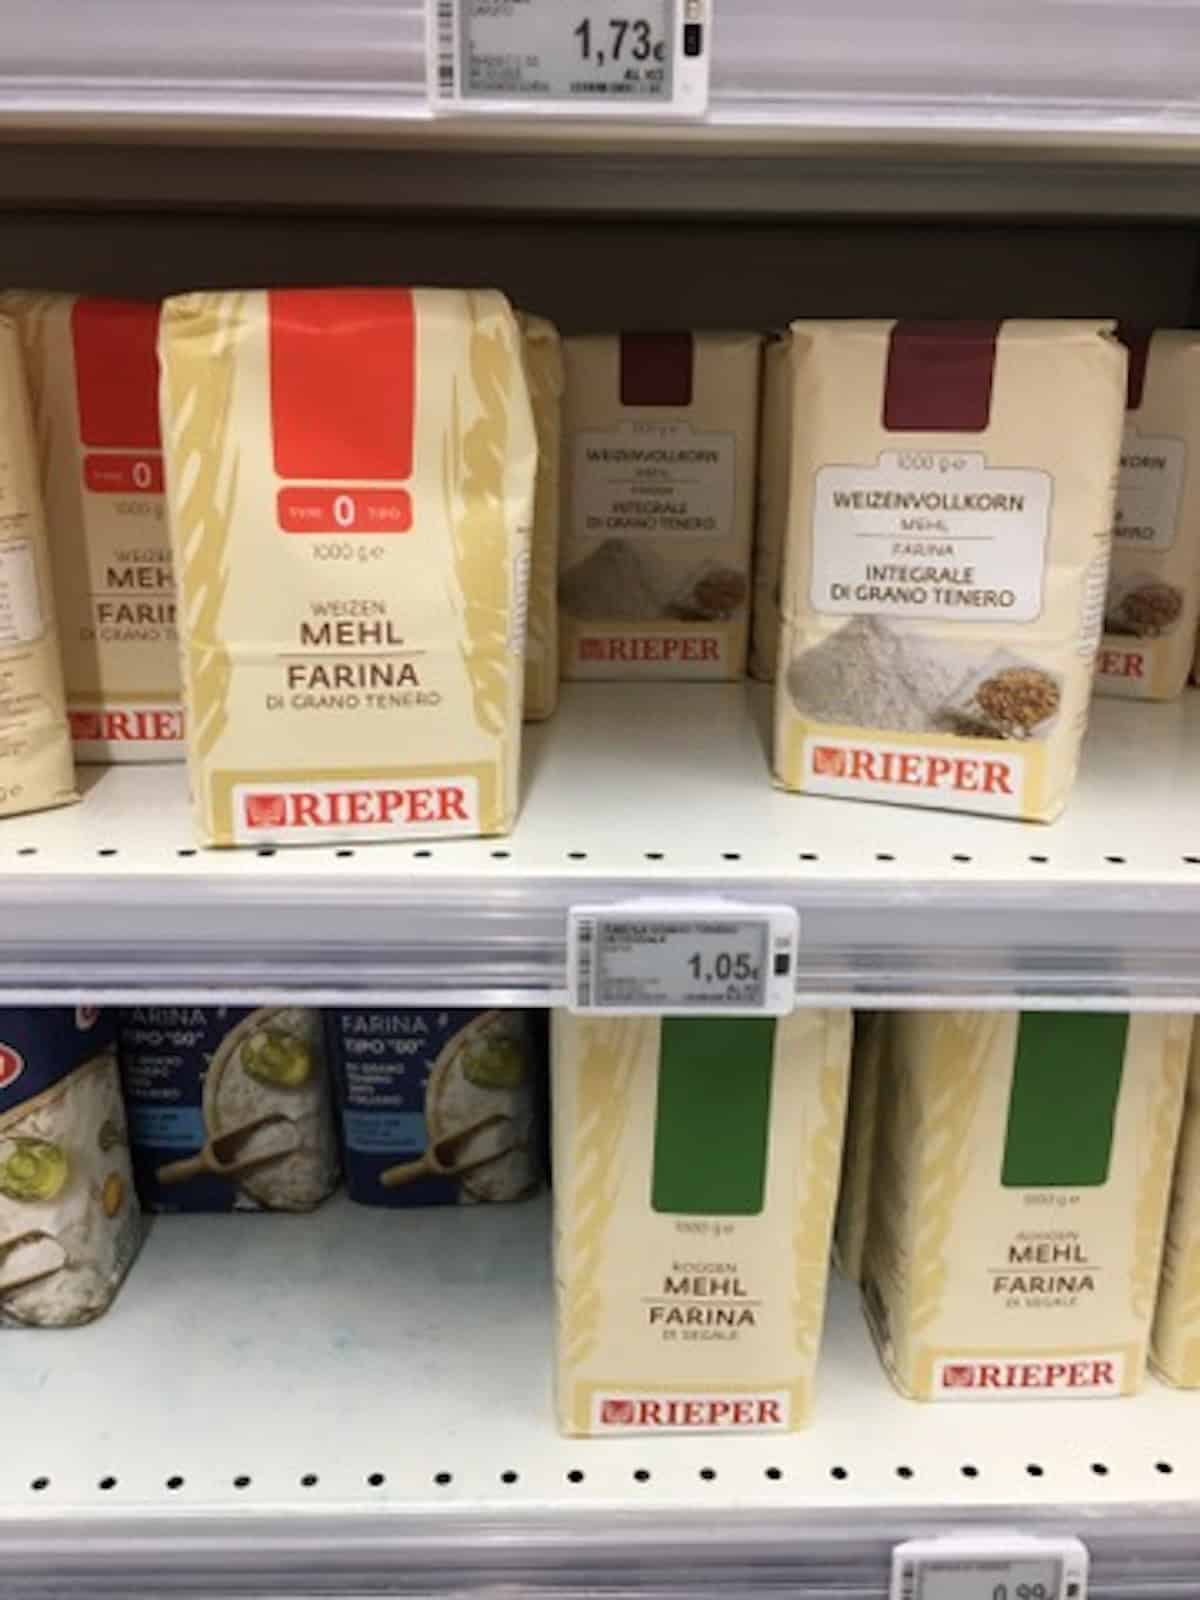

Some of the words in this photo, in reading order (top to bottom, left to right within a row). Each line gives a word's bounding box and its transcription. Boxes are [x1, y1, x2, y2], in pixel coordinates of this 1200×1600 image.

[574, 18, 666, 67] 1,73€
[332, 494, 355, 528] 0
[832, 491, 1025, 513] WEIZENVOLLKORN
[891, 544, 954, 557] FARINA
[106, 567, 175, 589] MEH
[865, 565, 976, 585] INTEGRALE
[830, 583, 851, 601] DI
[855, 585, 928, 606] GRANO
[934, 588, 1016, 608] TENERO
[311, 600, 386, 616] WEIZEN
[300, 621, 404, 646] MEHL
[608, 638, 720, 661] RIEPER
[287, 663, 420, 690] FARINA
[265, 695, 284, 711] DI
[290, 694, 359, 710] GRANO
[366, 692, 442, 709] TENERO
[851, 749, 1014, 794] RIEPER
[289, 787, 469, 827] RIEPER
[341, 1015, 429, 1033] FARINA
[1008, 1243, 1088, 1264] MEHL
[663, 1276, 748, 1297] MEHL
[992, 1275, 1095, 1294] FARINA
[649, 1306, 756, 1326] FARINA
[978, 1361, 1114, 1388] RIEPER
[639, 1399, 782, 1425] RIEPER
